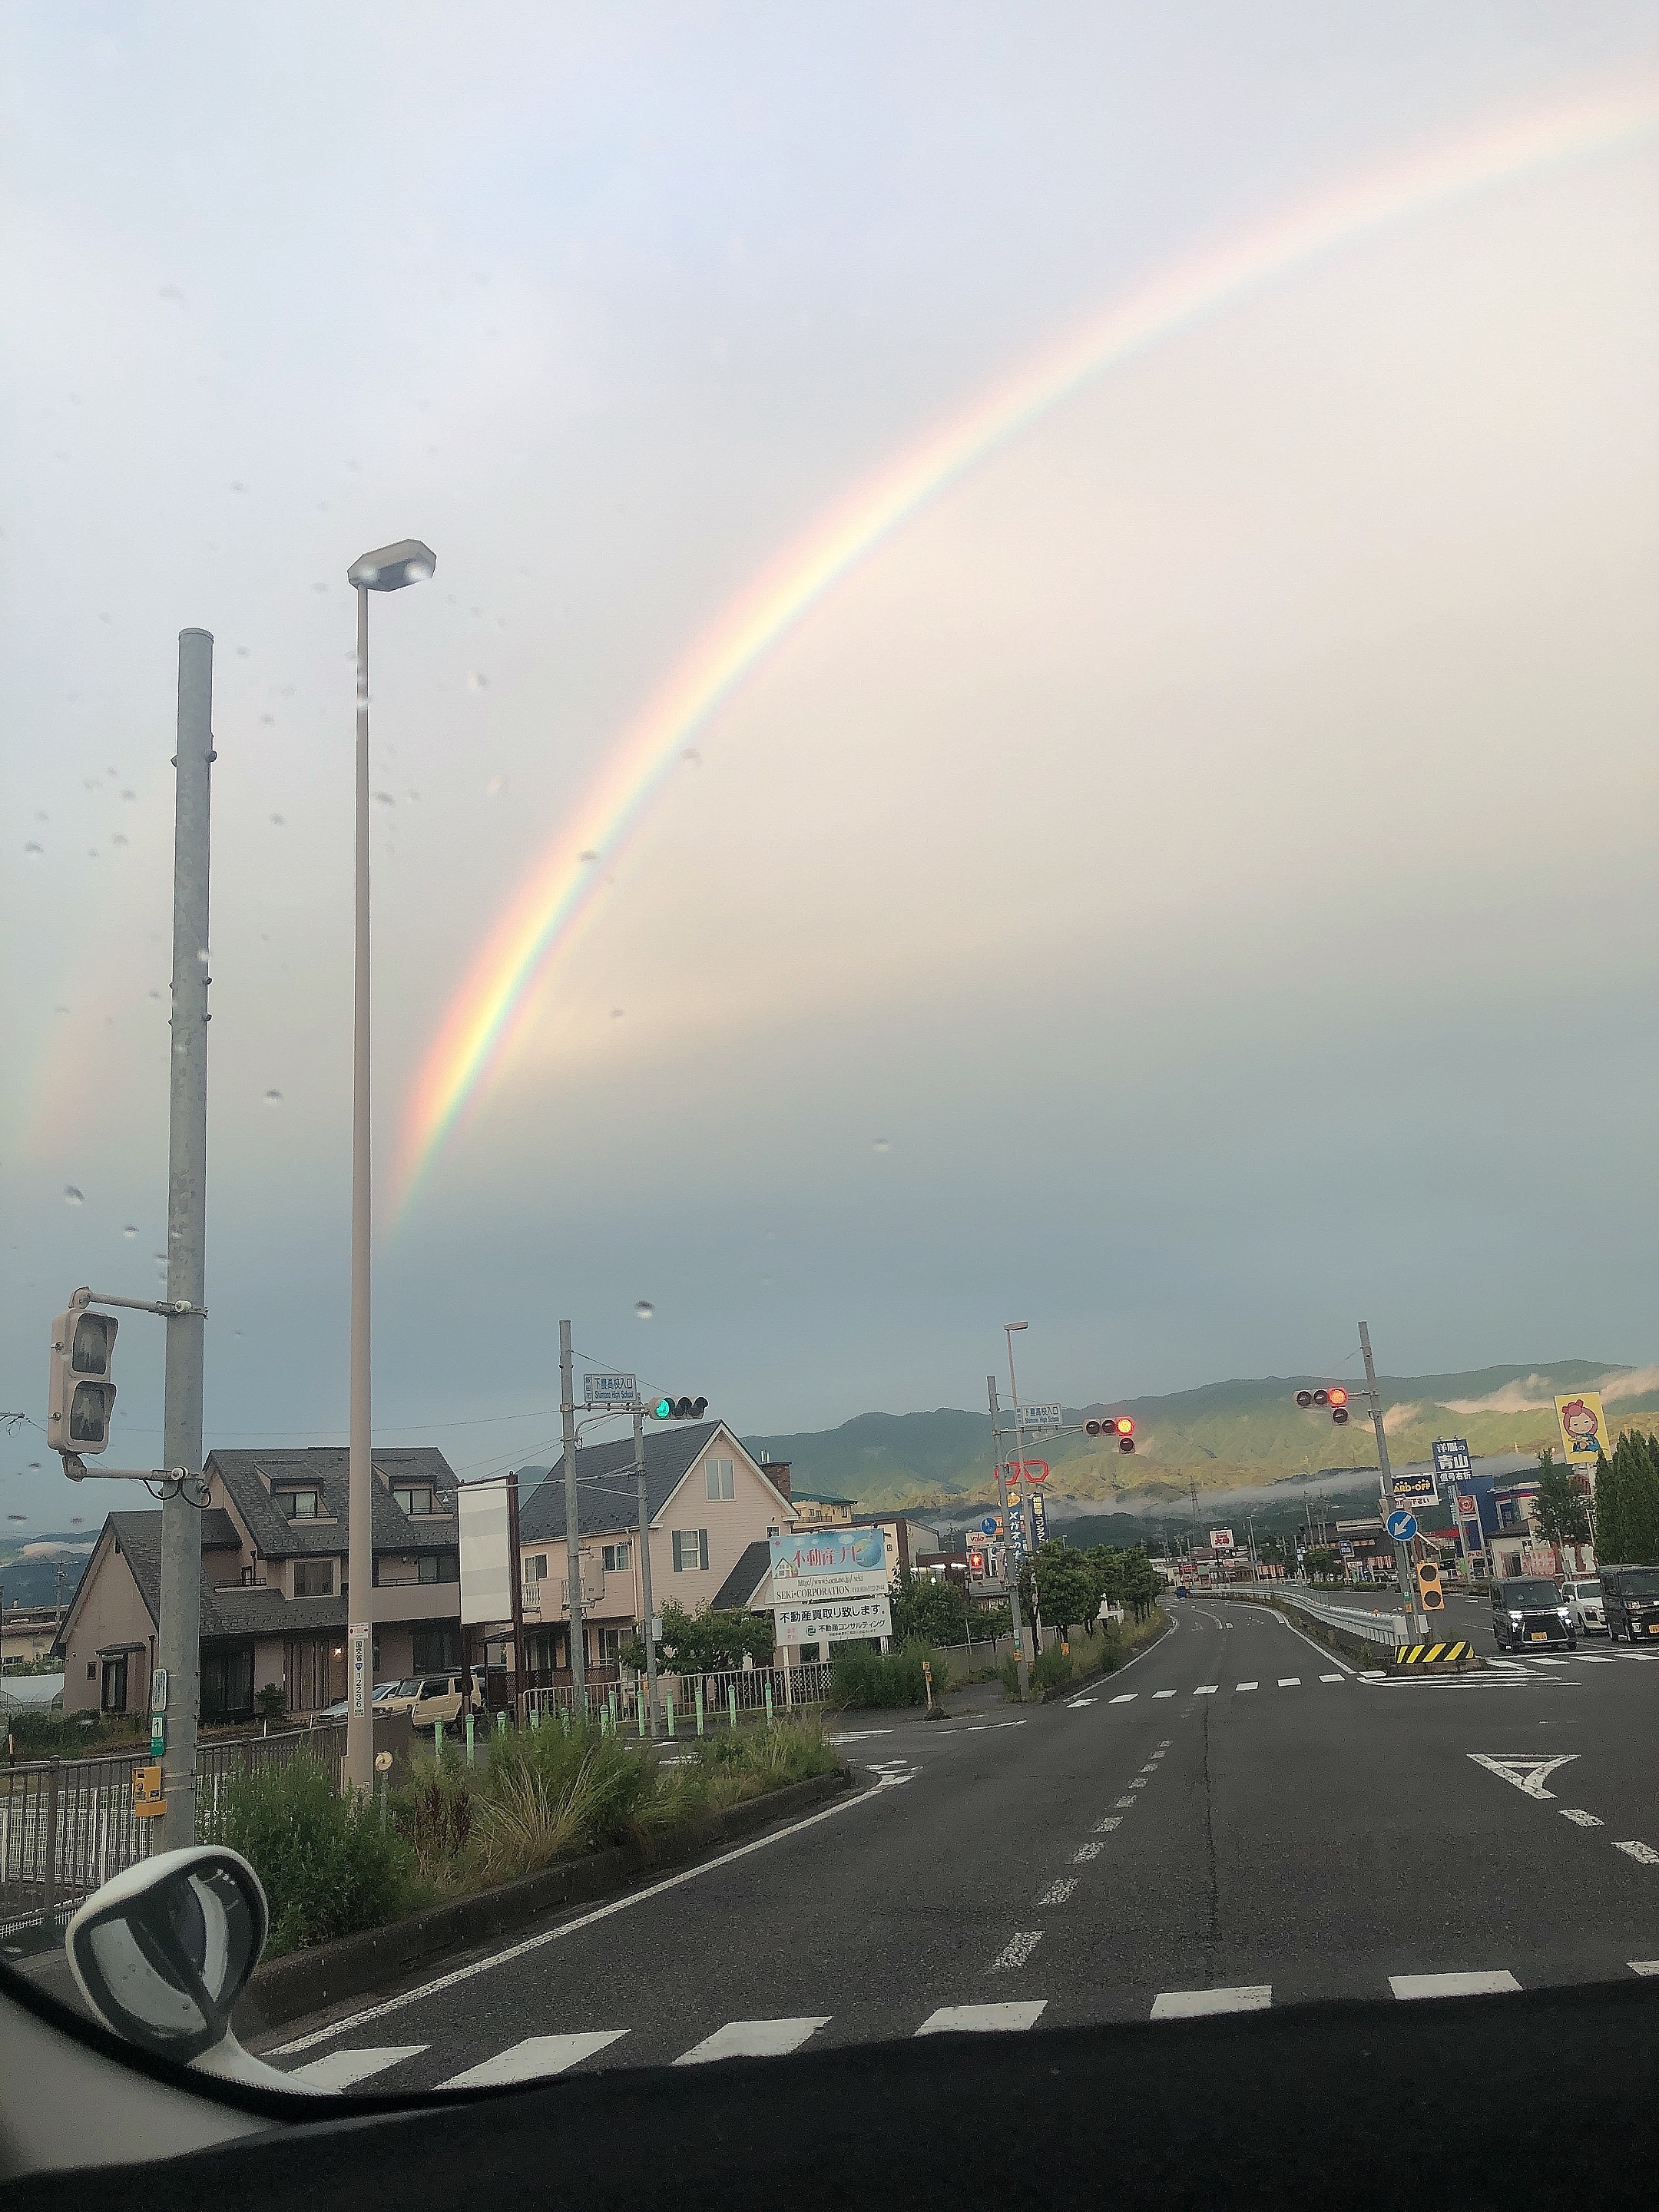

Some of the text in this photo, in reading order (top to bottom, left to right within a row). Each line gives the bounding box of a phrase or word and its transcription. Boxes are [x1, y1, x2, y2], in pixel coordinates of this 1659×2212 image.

[1436, 1442, 1465, 1452] 洋服の
[1437, 1454, 1469, 1469] 青山
[1440, 1471, 1472, 1482] 信号右折
[792, 1545, 863, 1568] 不動産ナビ
[780, 1604, 885, 1624] 不動産買取り致します。
[819, 1619, 886, 1633] 不動産コンサルティング
